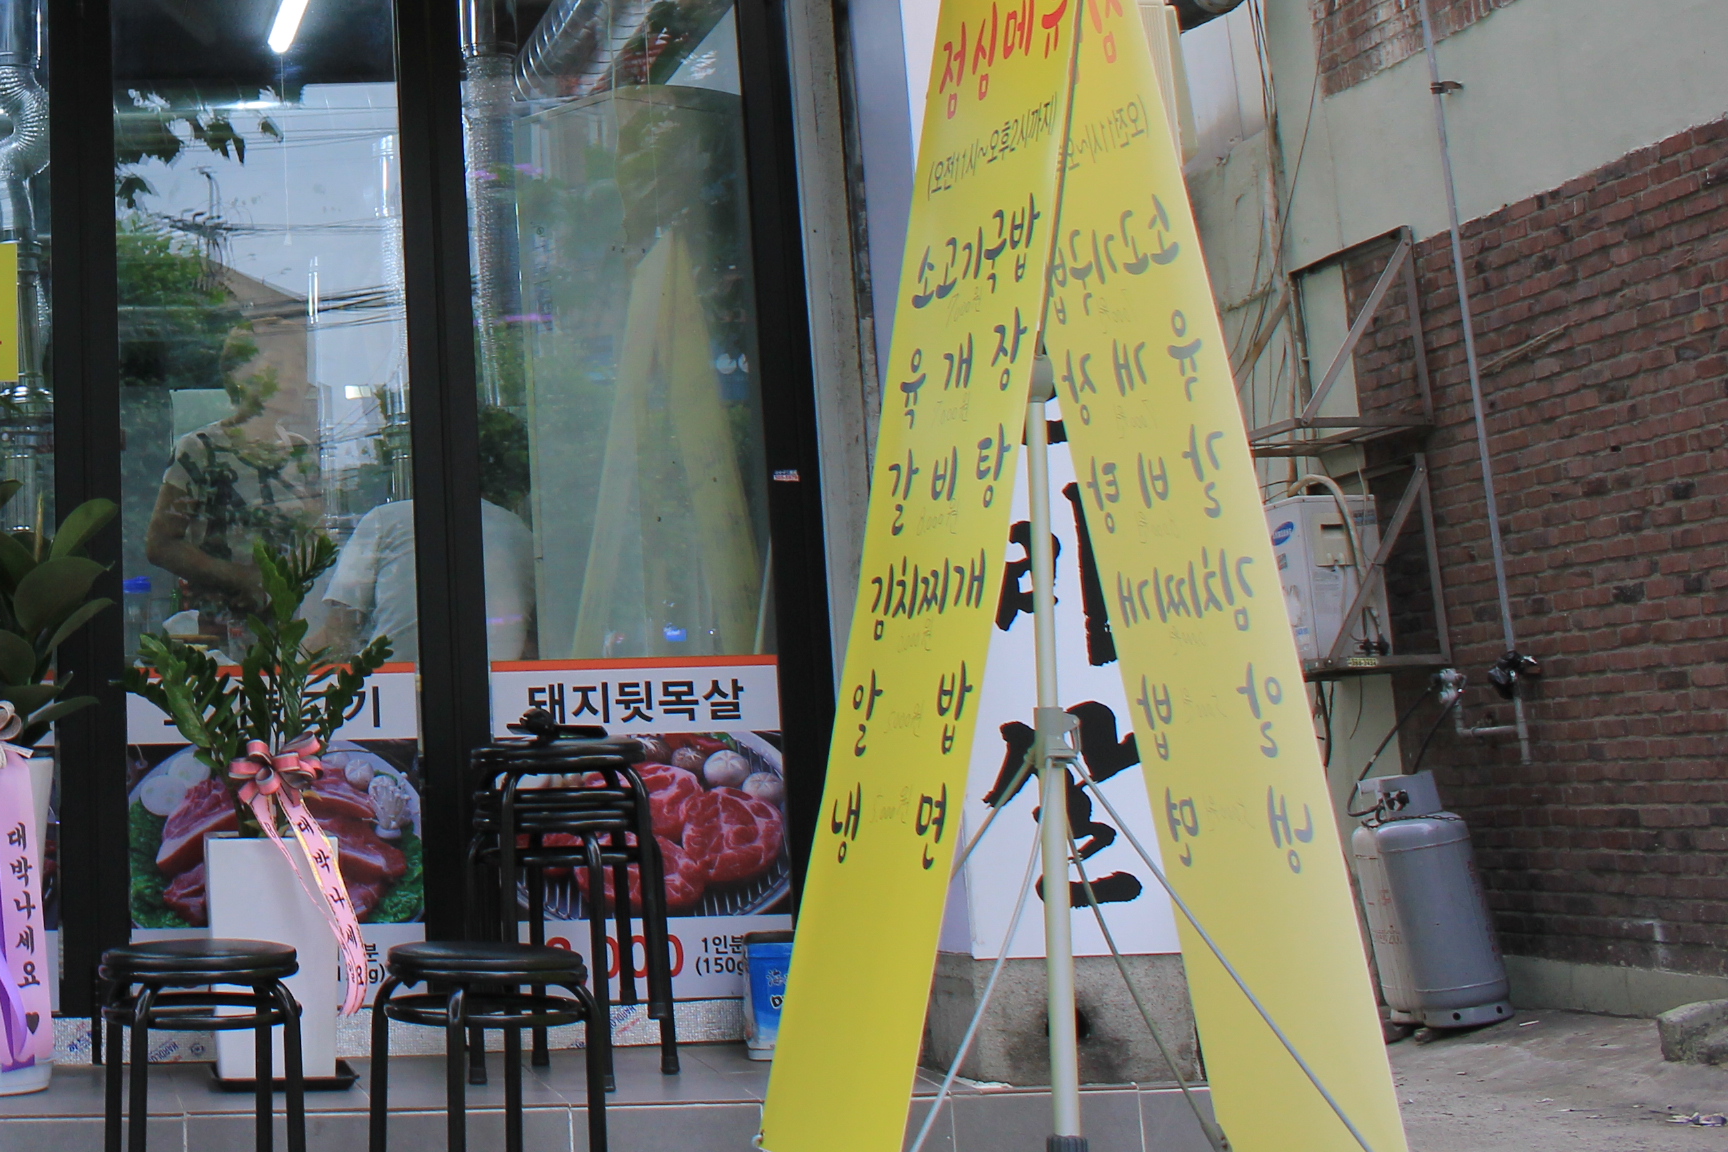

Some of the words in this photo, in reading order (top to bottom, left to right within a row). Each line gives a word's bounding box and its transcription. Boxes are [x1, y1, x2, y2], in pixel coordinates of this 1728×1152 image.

[912, 192, 1040, 309] 소고기국밥
[900, 307, 1028, 429] 육개장
[888, 422, 1012, 537] 갈비탕
[870, 547, 986, 642] 김치찌개
[527, 679, 745, 725] 돼지뒷목살
[7, 821, 41, 988] 대박나세요
[694, 956, 744, 977] (150g
